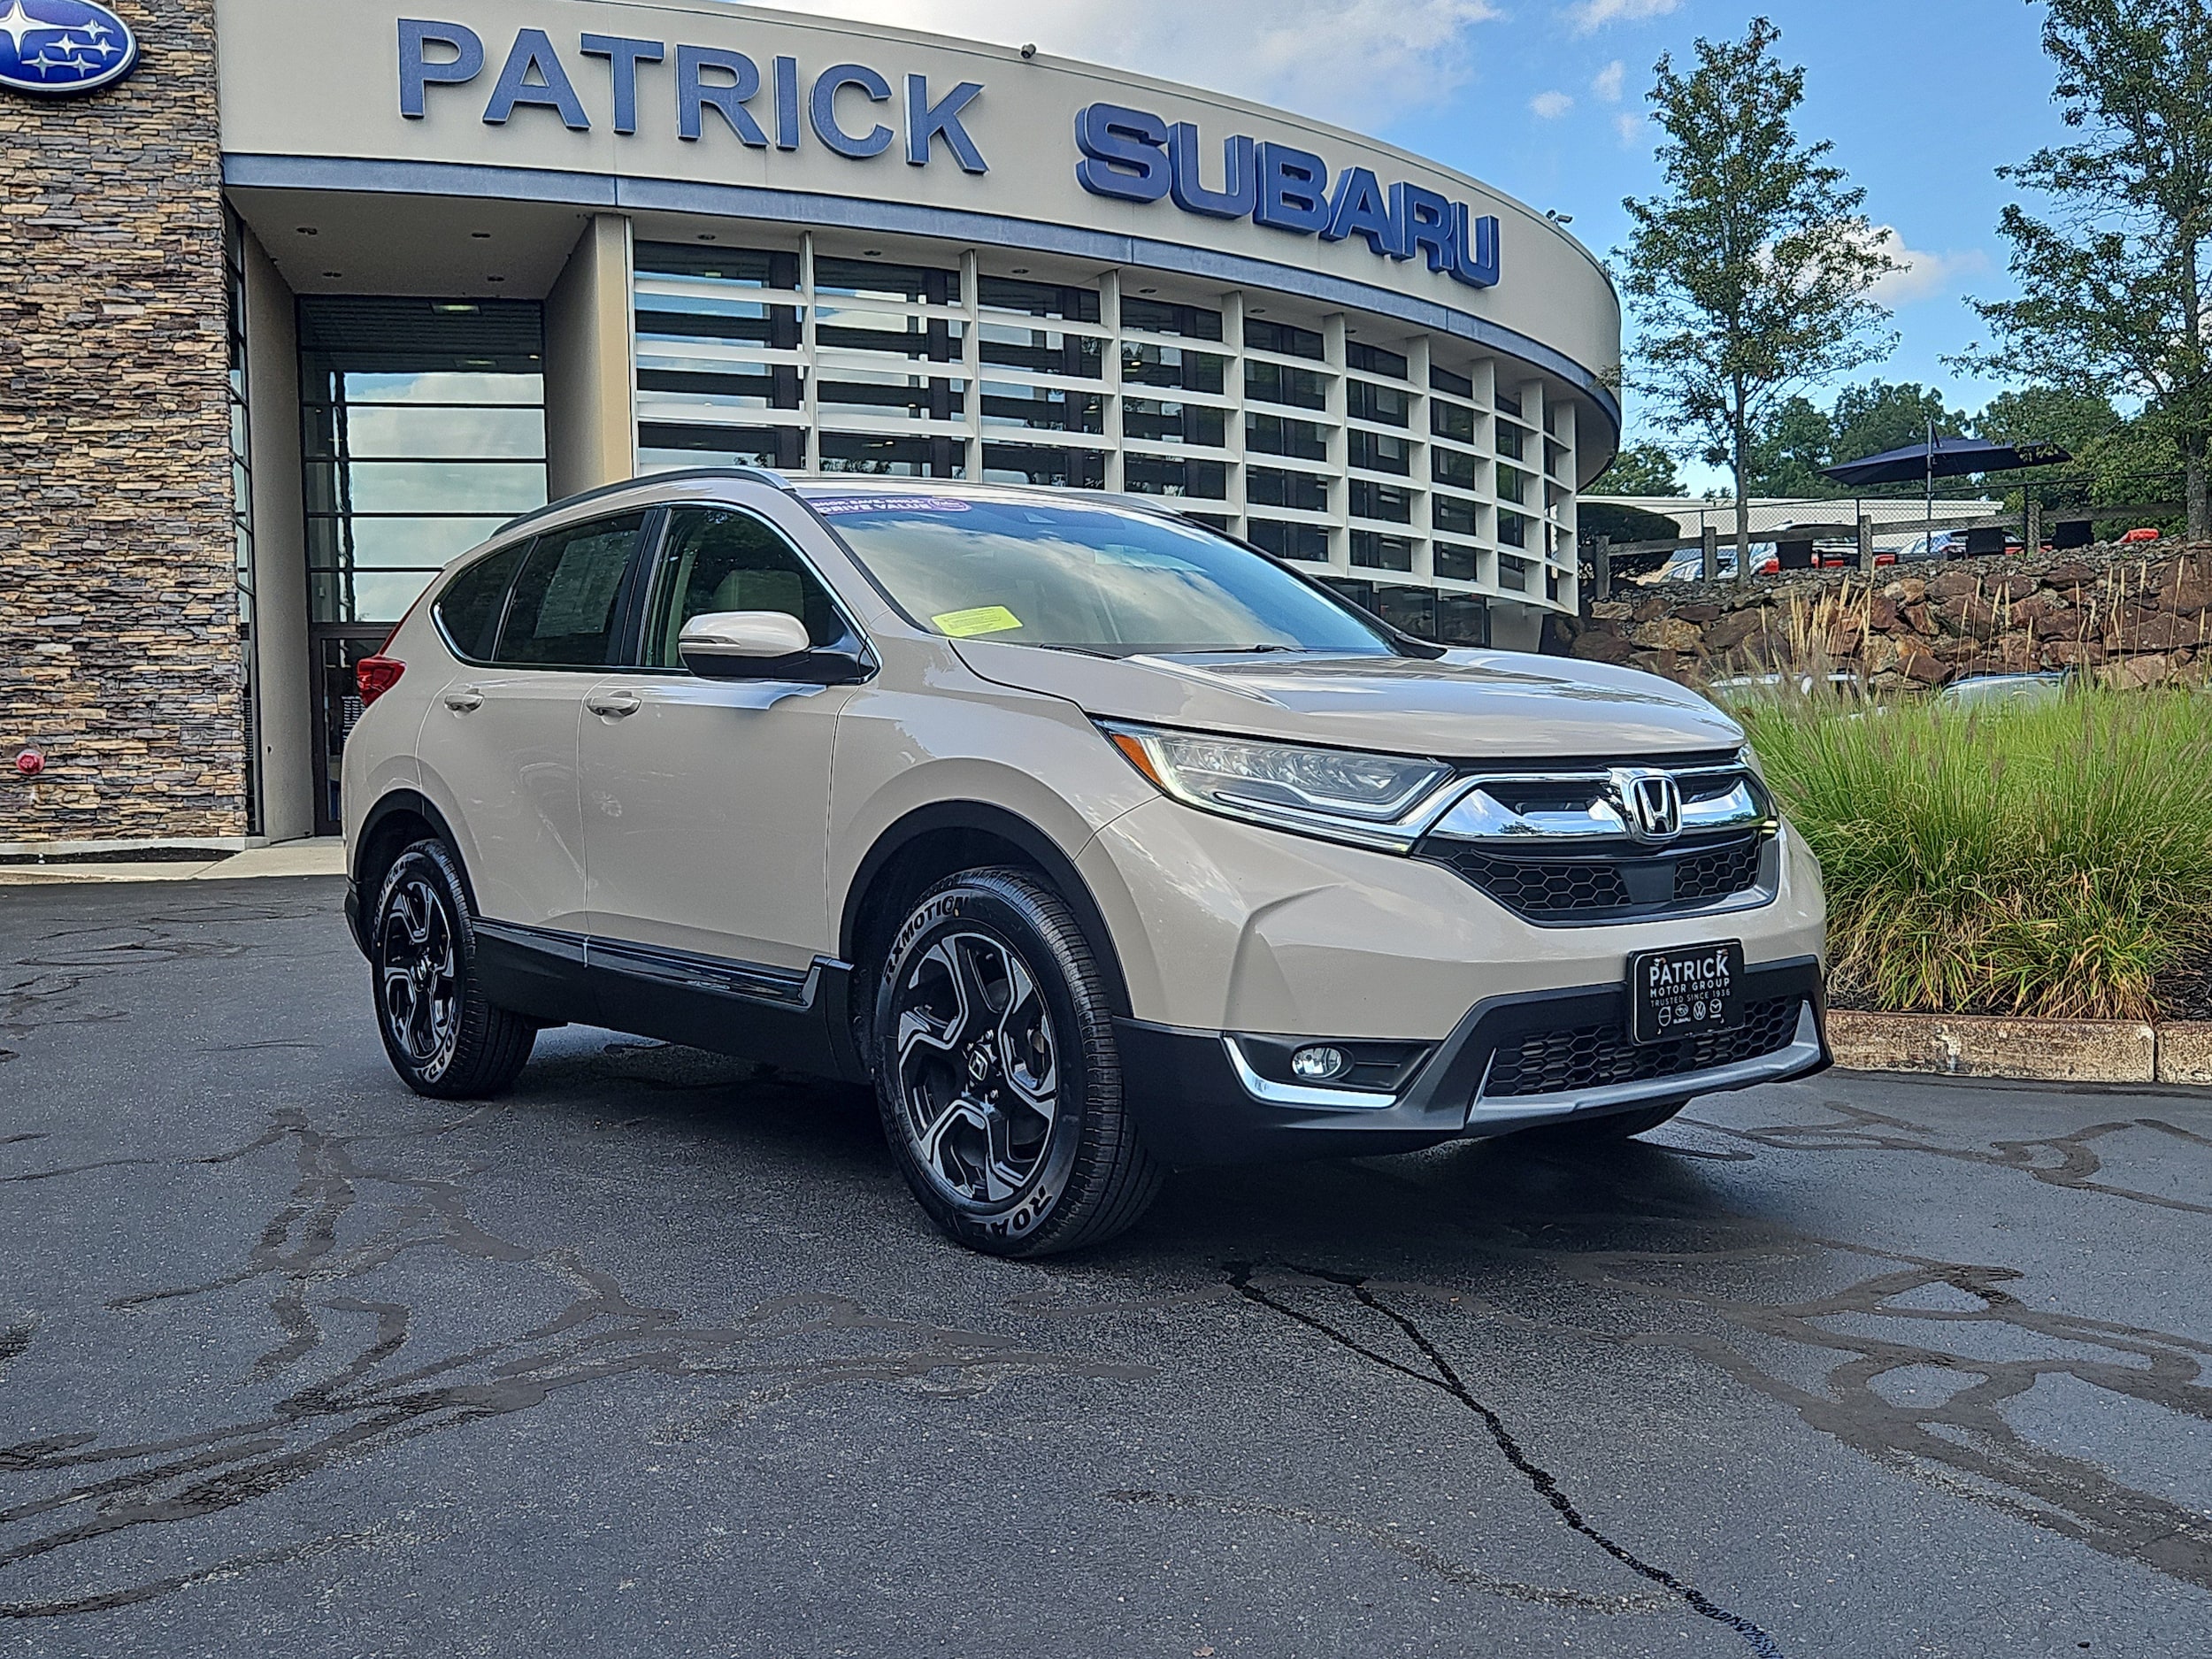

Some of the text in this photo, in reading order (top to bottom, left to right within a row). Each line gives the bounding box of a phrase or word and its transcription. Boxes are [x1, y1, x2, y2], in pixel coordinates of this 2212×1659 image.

[397, 18, 1500, 289] PATRICK SUBARU
[816, 503, 873, 514] DRIVE
[1649, 956, 1730, 987] PATRICK
[1649, 978, 1731, 998] MOTOR GROUP
[1650, 995, 1684, 1008] TRUSTED
[1686, 991, 1709, 1002] SINCE
